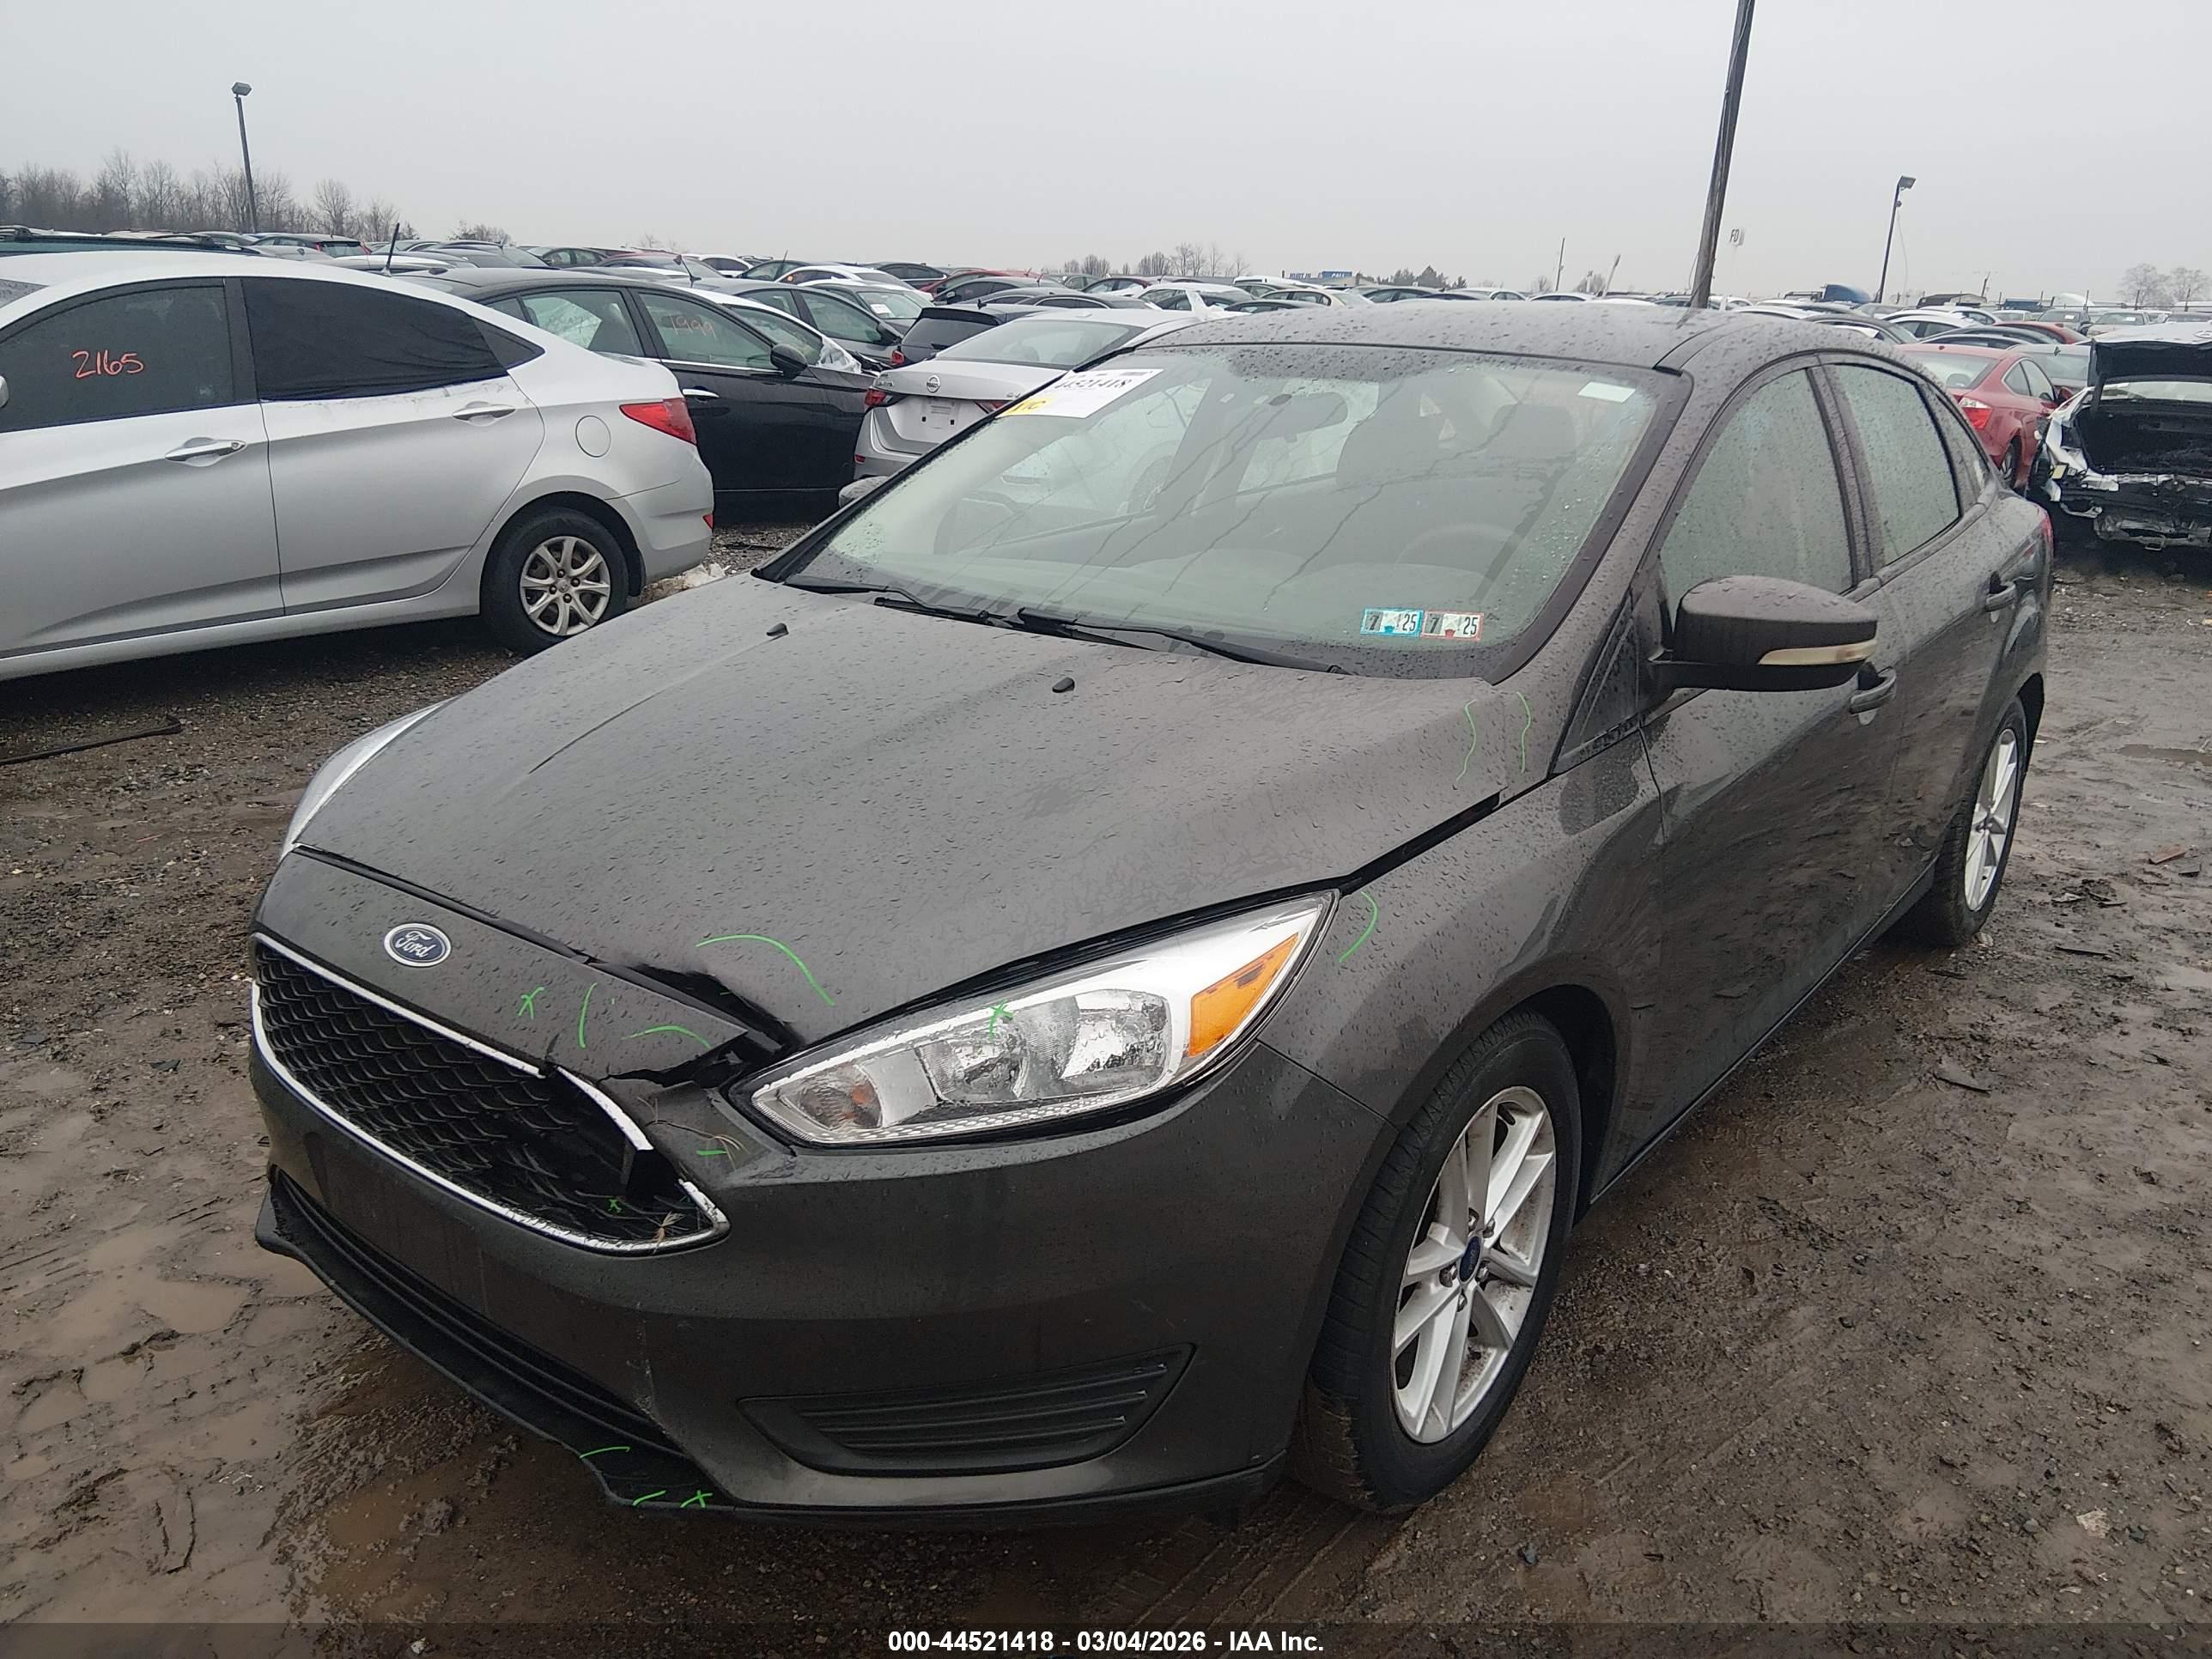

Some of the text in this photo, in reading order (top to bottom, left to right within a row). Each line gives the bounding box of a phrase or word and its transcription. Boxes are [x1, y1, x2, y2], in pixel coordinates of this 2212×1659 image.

[72, 349, 145, 379] 2165
[1370, 613, 1418, 632] 7 25
[1429, 617, 1479, 635] 7 25
[394, 930, 437, 958] Ford
